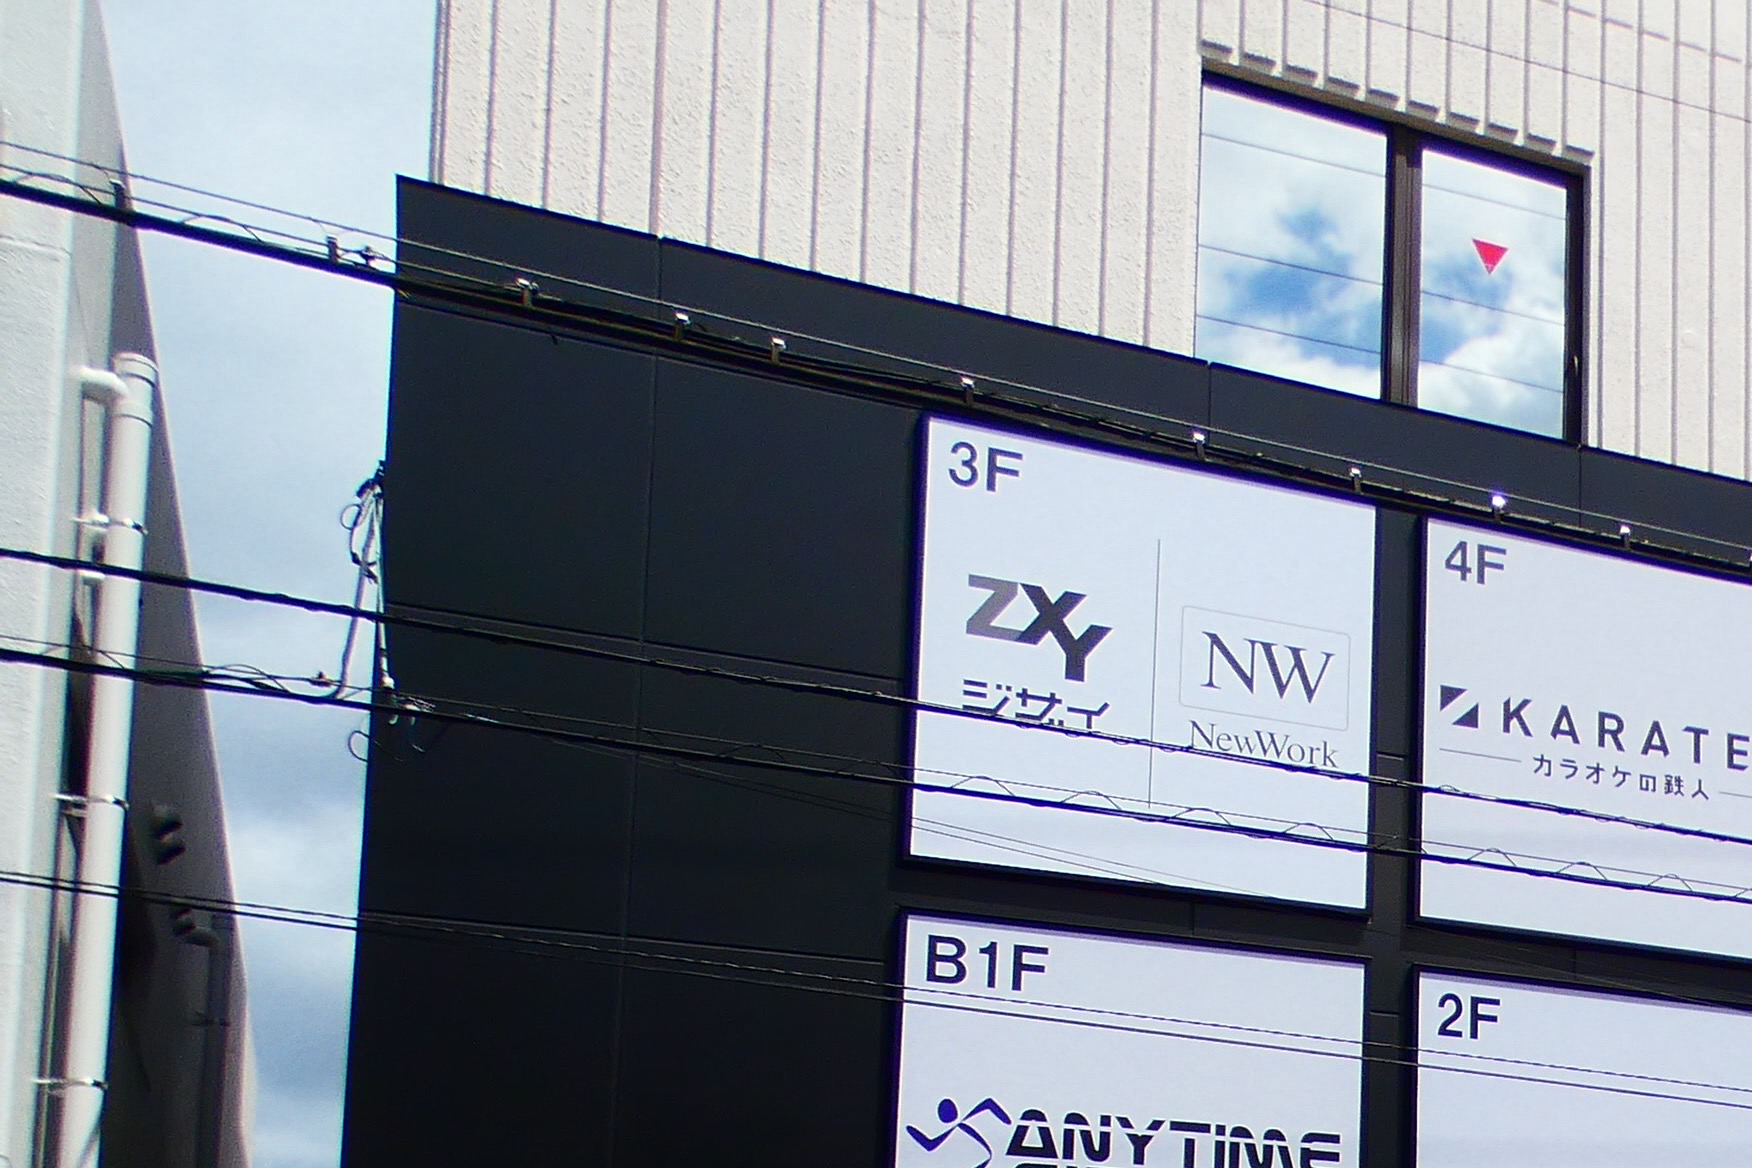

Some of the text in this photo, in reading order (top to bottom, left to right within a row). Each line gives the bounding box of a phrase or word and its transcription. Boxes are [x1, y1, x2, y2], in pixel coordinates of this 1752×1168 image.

[949, 441, 1023, 492] 3F
[1444, 540, 1507, 585] 4F
[965, 573, 1113, 683] ZXY
[1200, 631, 1336, 704] NW
[1188, 719, 1339, 769] NewWork
[1532, 753, 1710, 801] カラオケの鉄人
[925, 934, 1049, 991] B1F
[1437, 992, 1501, 1041] 2F
